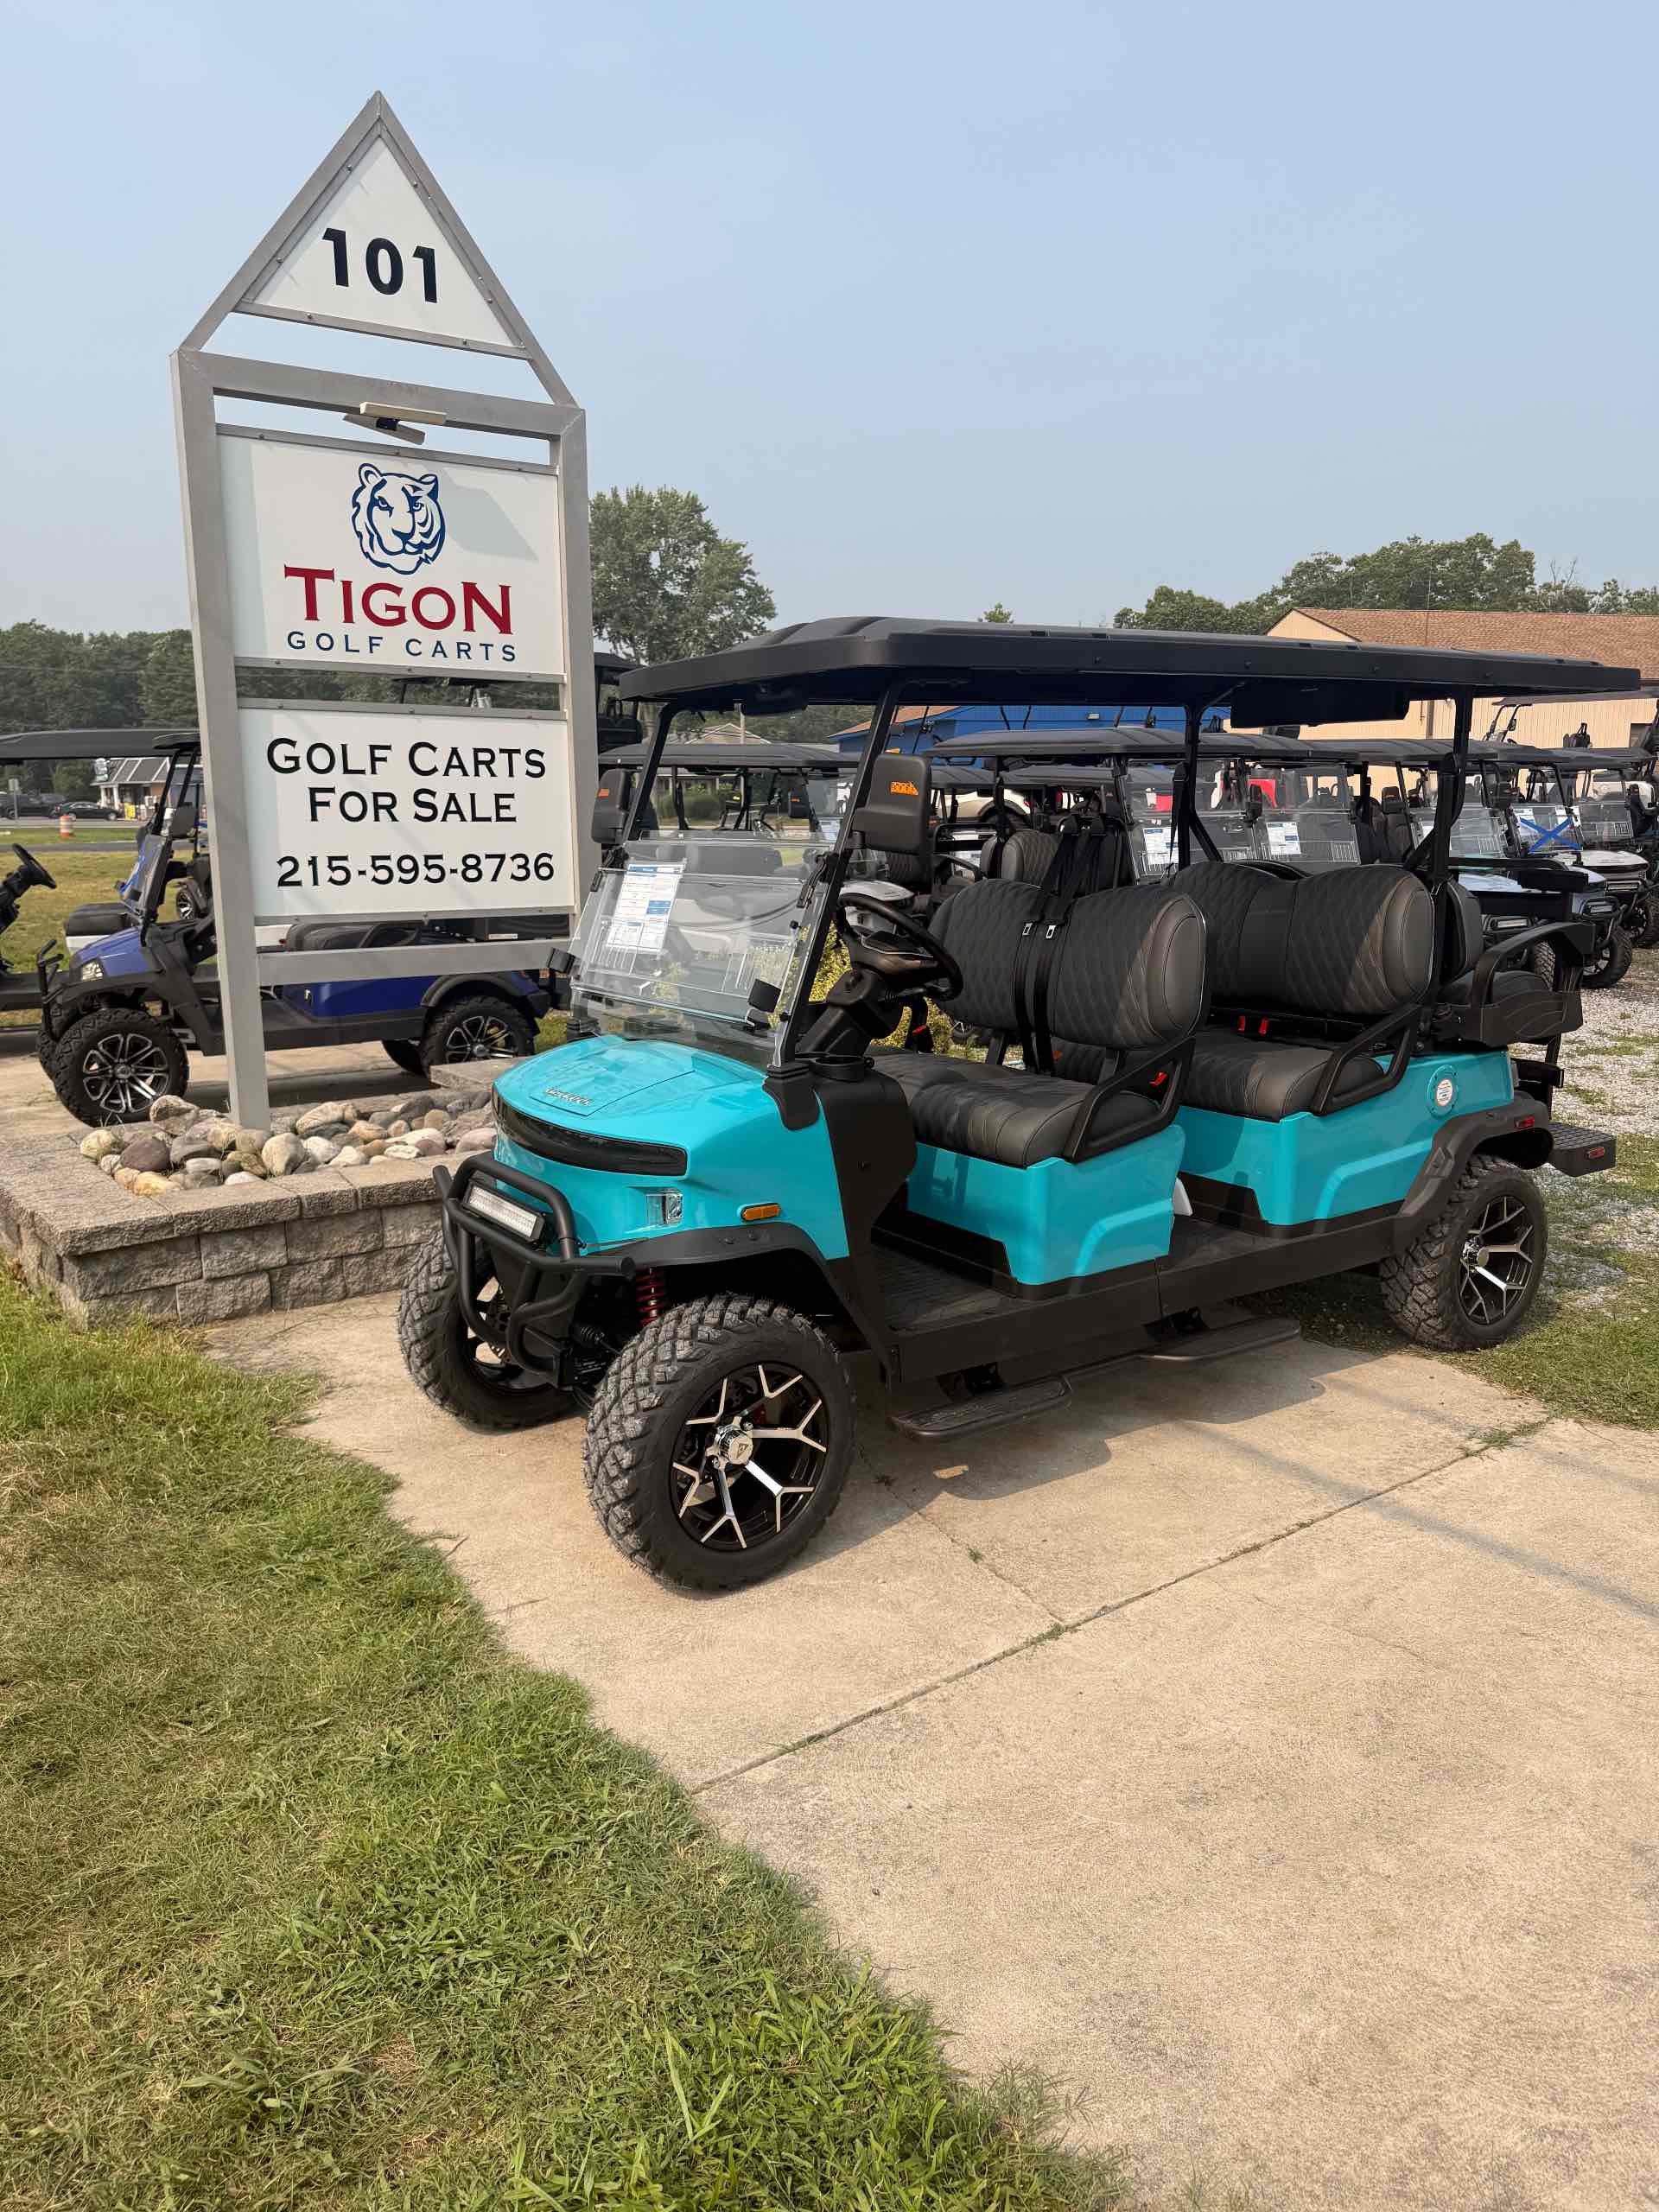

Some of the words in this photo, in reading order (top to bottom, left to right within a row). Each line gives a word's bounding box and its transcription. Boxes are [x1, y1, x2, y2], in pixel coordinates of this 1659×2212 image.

[322, 227, 437, 303] 101
[284, 563, 513, 635] TIGON
[287, 631, 384, 654] GOLF
[405, 639, 516, 662] CARTS
[266, 737, 392, 775] GOLF
[408, 741, 546, 779] CARTS
[307, 786, 399, 823] FOR
[413, 787, 518, 823] SALE
[276, 852, 555, 887] 215-595-8736
